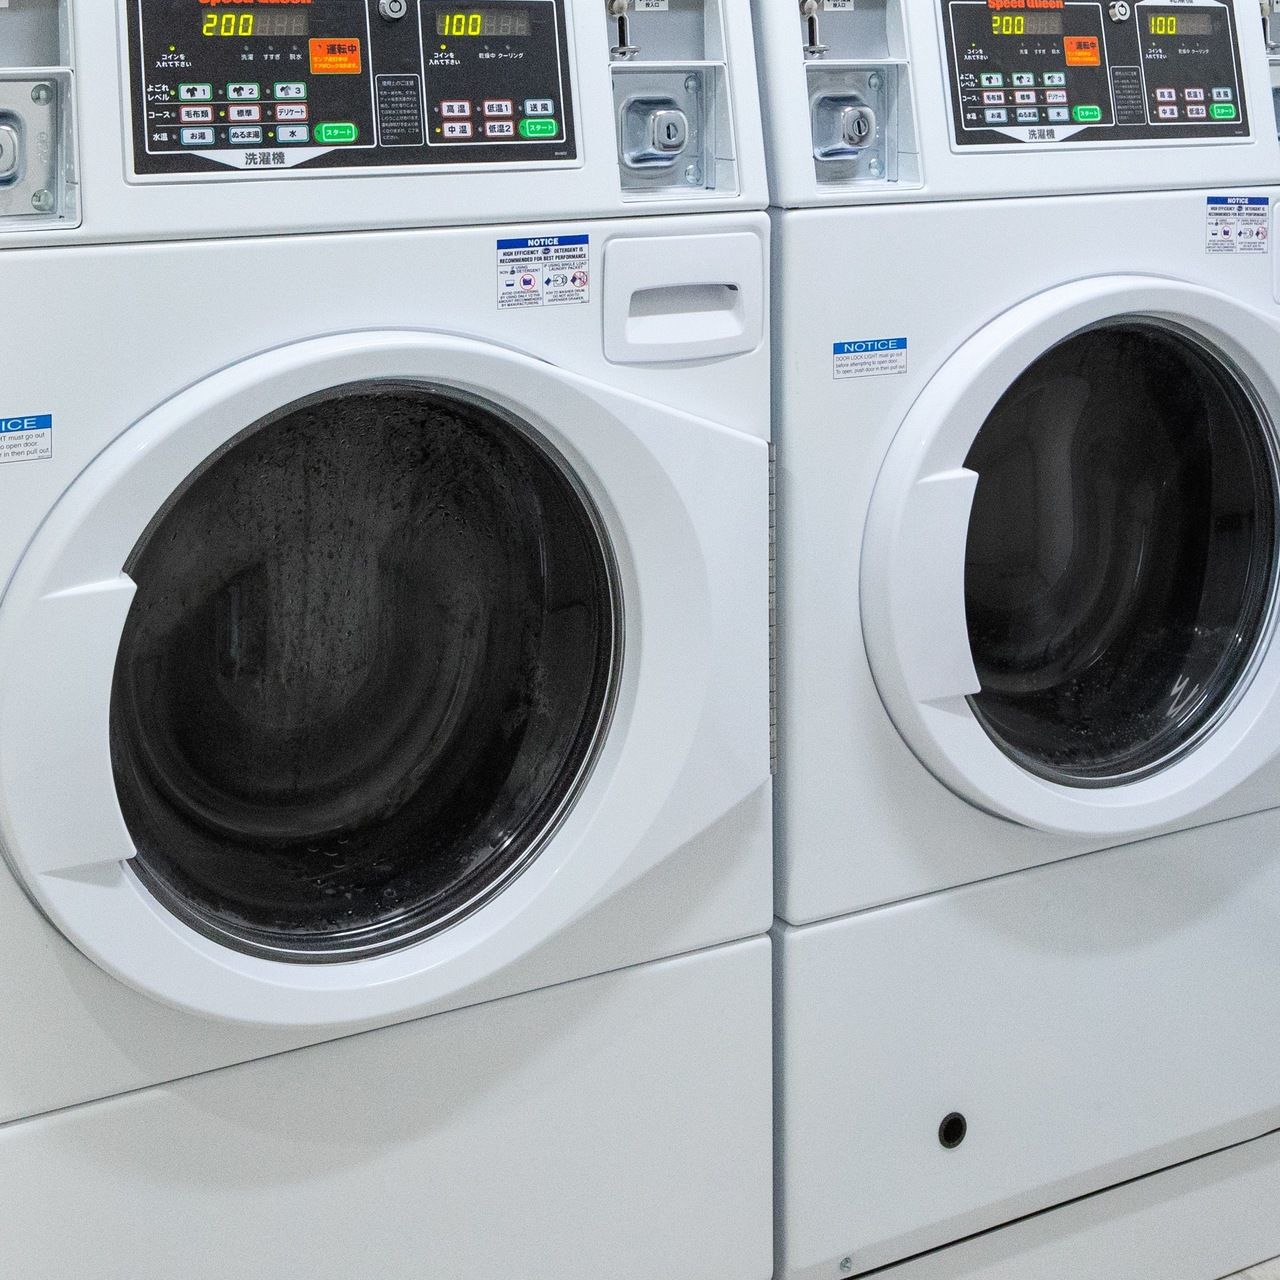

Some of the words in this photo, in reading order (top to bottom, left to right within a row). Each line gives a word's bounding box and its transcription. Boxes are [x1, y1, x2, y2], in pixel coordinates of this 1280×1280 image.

[202, 14, 253, 36] 200
[444, 14, 481, 36] 100
[1151, 16, 1176, 34] 100
[327, 44, 357, 54] 運転中
[148, 93, 169, 101] レベル
[184, 110, 208, 118] 毛布類
[153, 133, 168, 141] 水温
[190, 132, 205, 141] お湯
[232, 131, 259, 139] ぬるま湯
[1028, 129, 1055, 139] 洗濯機
[245, 152, 285, 165] 洗濯機
[528, 238, 559, 246] NOTICE
[844, 340, 897, 352] NOTICE
